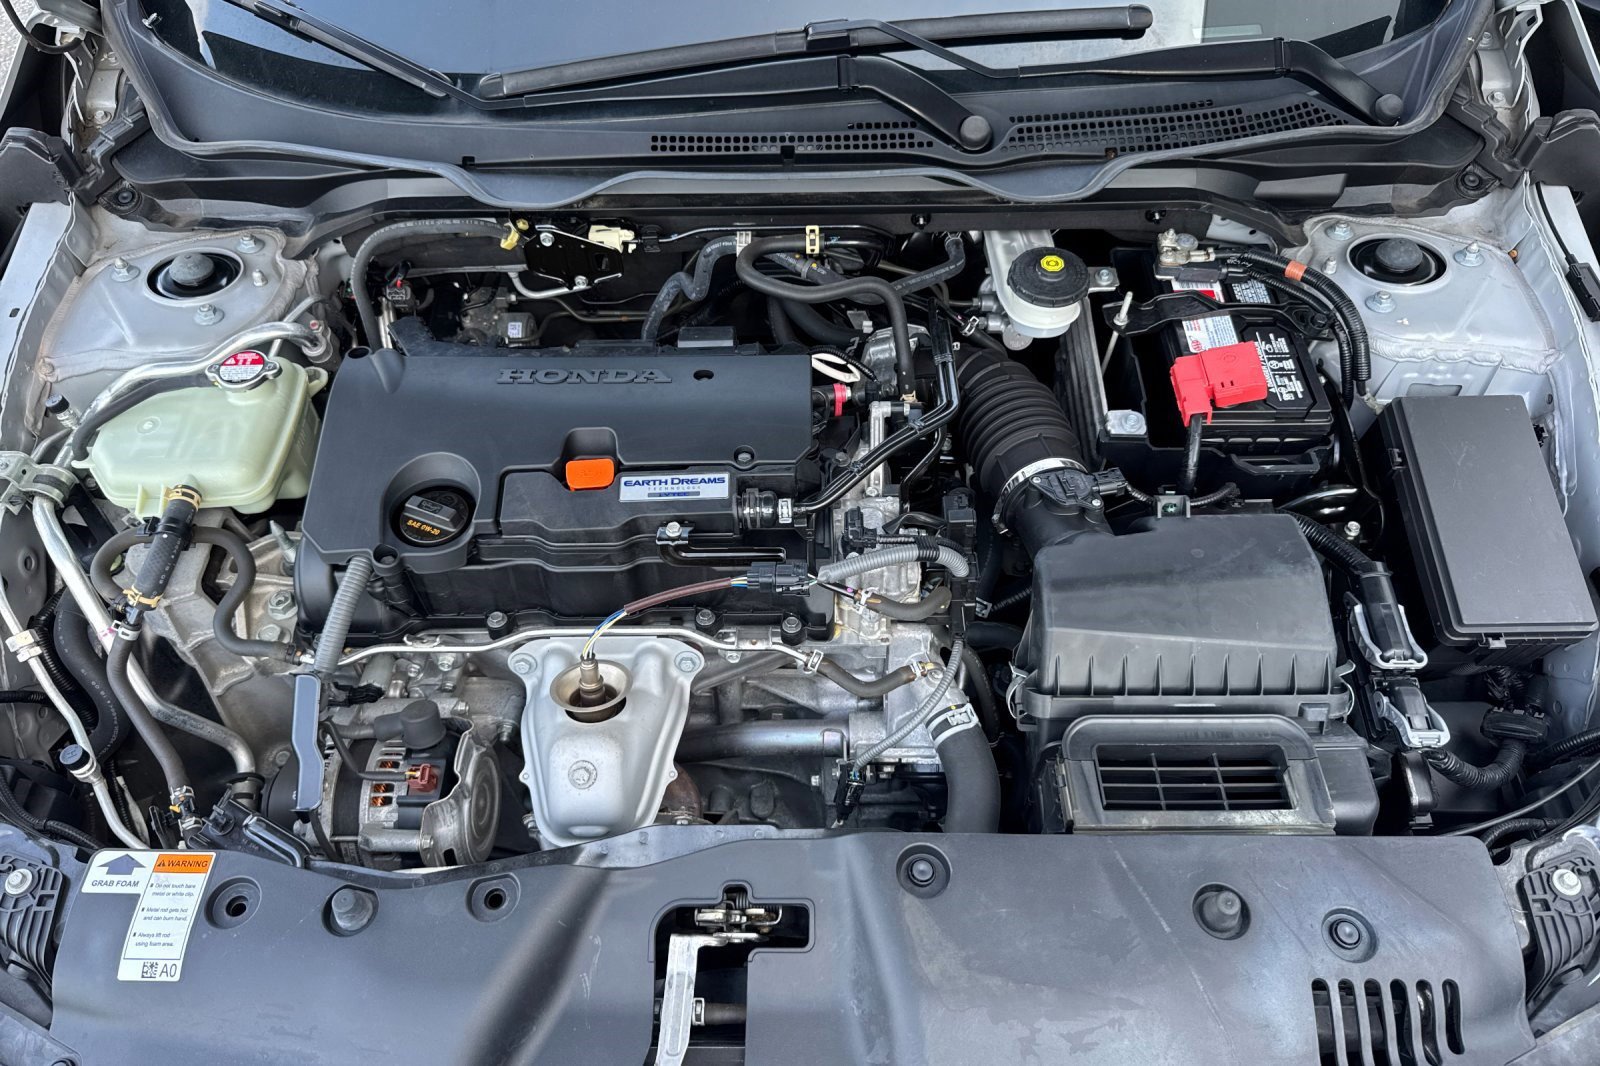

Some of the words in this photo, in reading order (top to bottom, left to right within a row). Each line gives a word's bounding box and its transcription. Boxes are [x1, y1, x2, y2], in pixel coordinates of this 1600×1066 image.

[497, 368, 672, 384] HONDA
[670, 477, 726, 485] DREAMS
[407, 519, 421, 528] SAE
[421, 524, 440, 535] 0W-20
[116, 880, 139, 888] FOAM
[159, 963, 177, 977] A0
